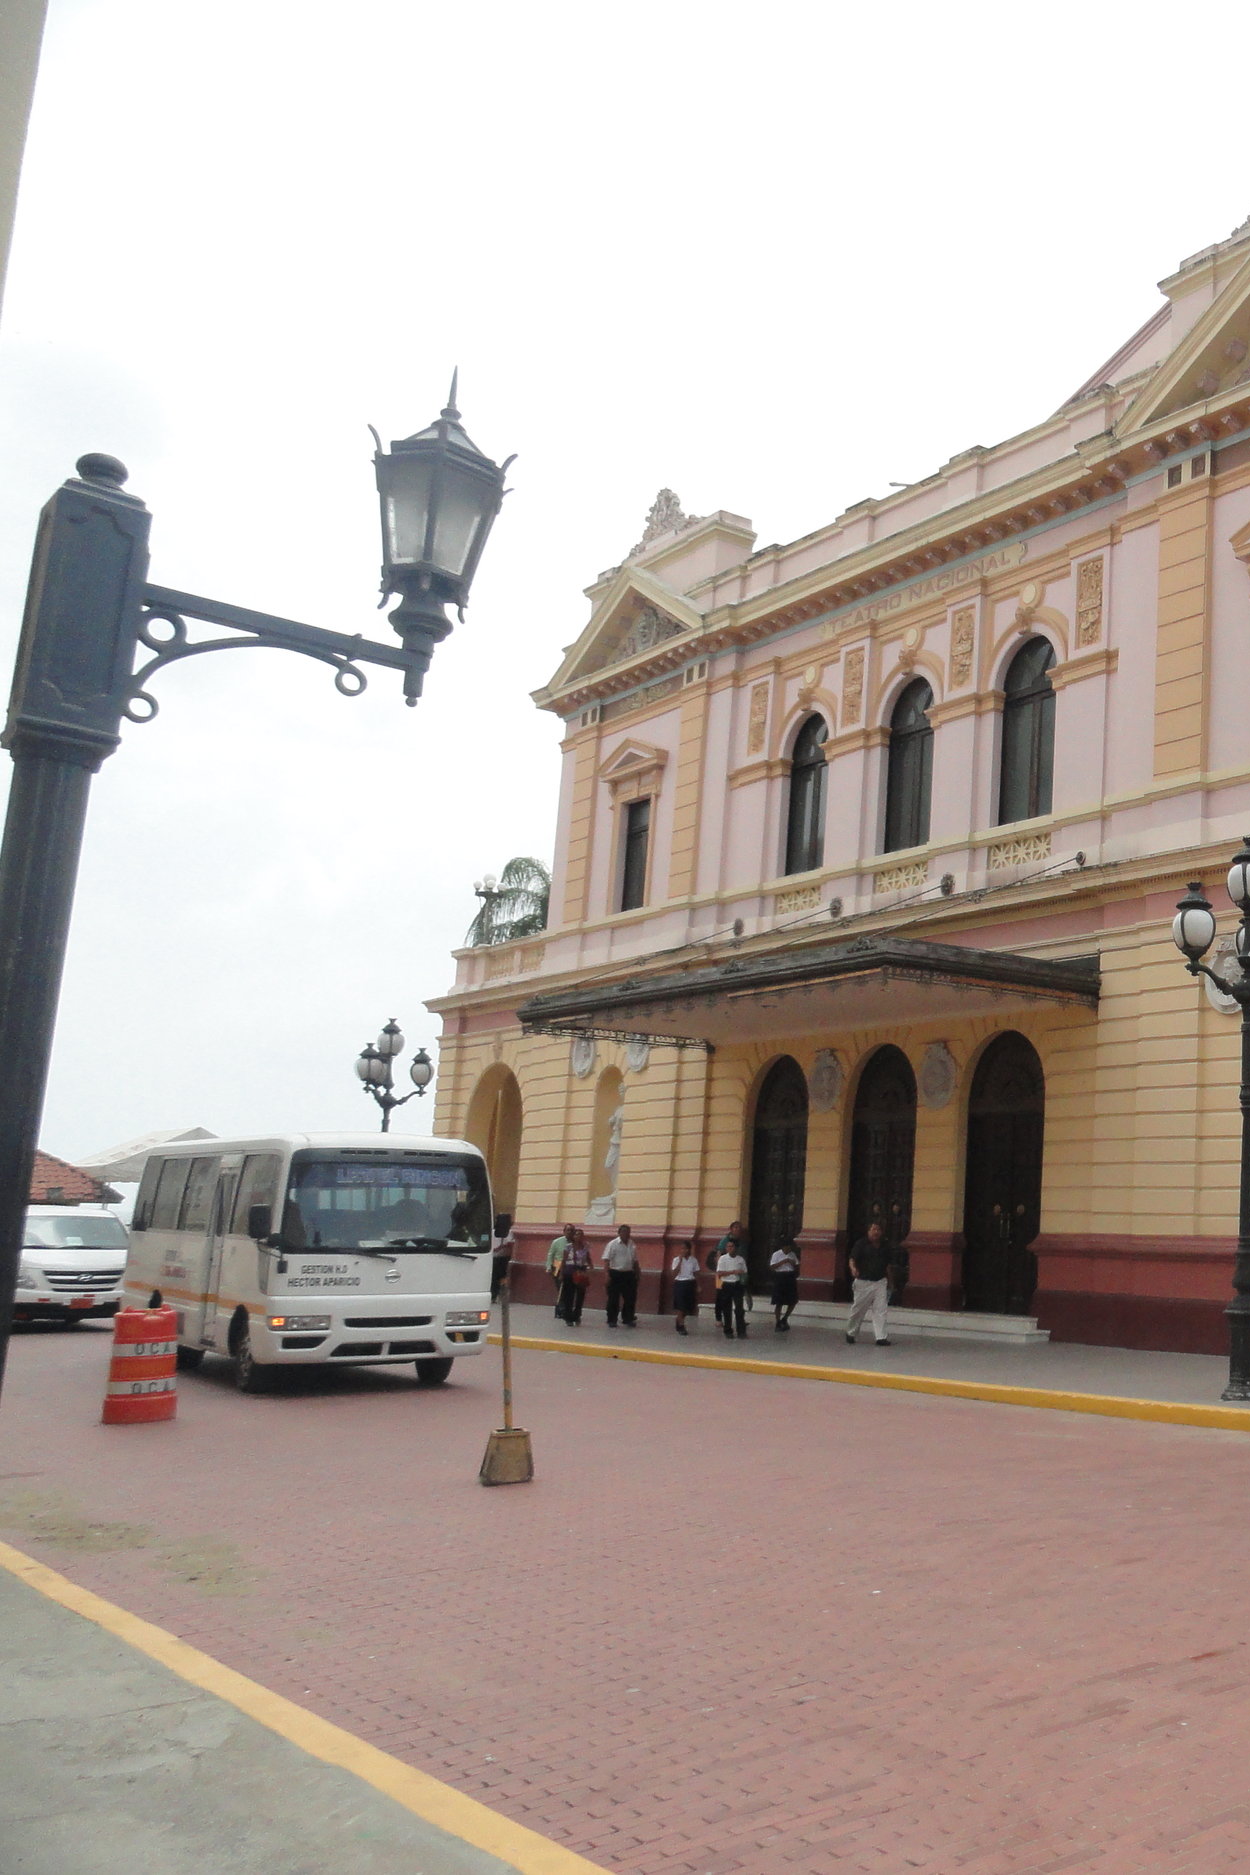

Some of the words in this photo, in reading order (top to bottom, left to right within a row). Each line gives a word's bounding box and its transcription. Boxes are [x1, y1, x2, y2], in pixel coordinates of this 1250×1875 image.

[829, 592, 901, 635] TEATRO
[908, 551, 1011, 601] NACIONAL
[287, 1277, 320, 1287] HECTOR
[322, 1276, 361, 1287] APARICIO
